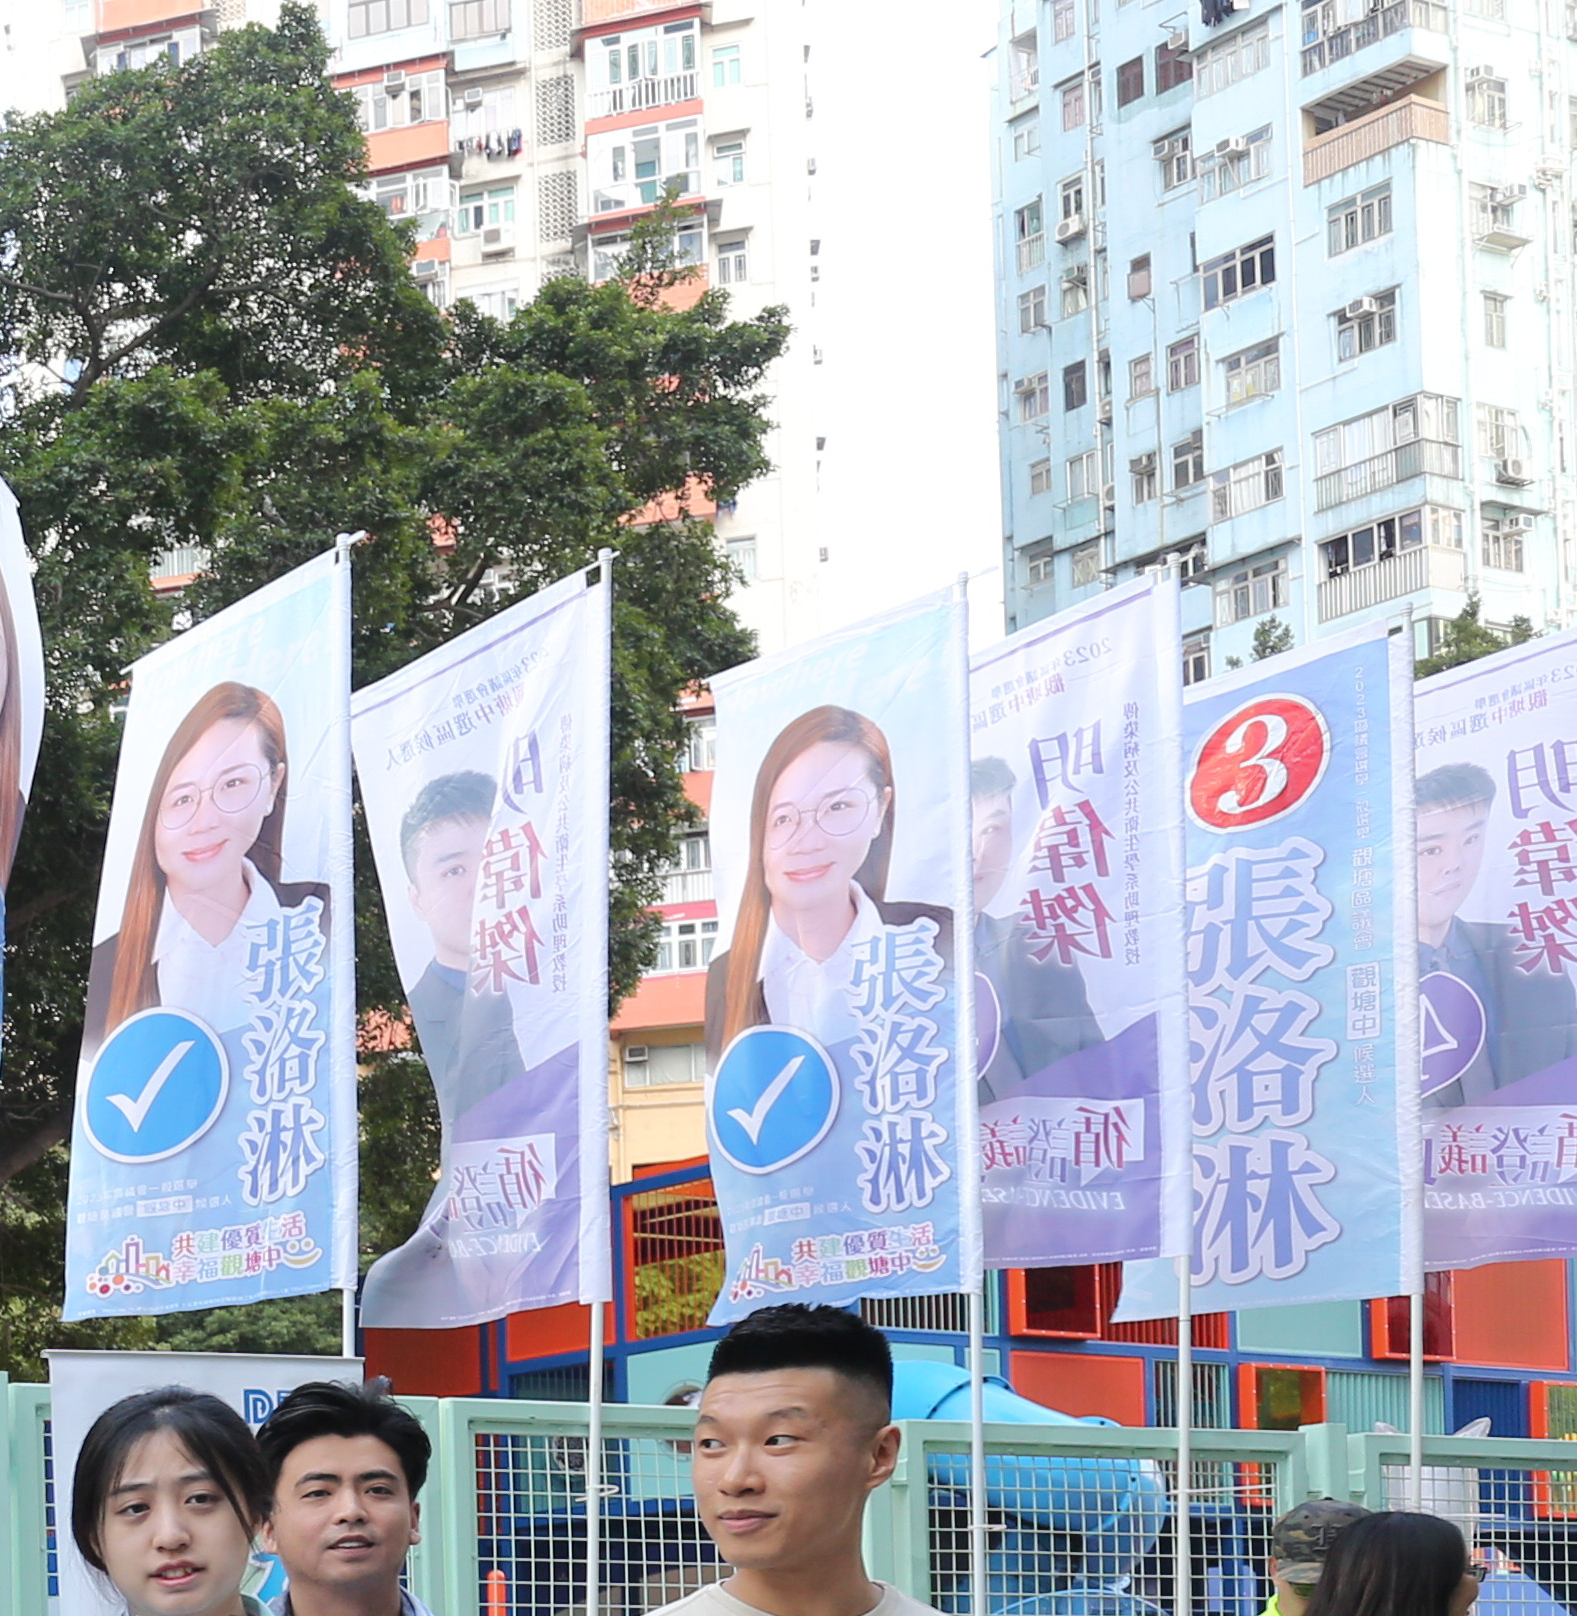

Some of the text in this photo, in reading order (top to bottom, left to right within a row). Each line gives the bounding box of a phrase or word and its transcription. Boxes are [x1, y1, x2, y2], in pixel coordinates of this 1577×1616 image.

[1219, 712, 1289, 816] 3
[1351, 965, 1377, 1036] 觀塘中
[244, 908, 322, 1197] 張洛淋
[854, 922, 947, 1207] 張洛淋
[1187, 846, 1329, 1273] 張洛淋
[1354, 1044, 1376, 1105] 候選人
[175, 1212, 305, 1257] 共建優質生活
[175, 1247, 282, 1284] 幸福觀塘中
[797, 1223, 933, 1261] 共建優質生活
[798, 1253, 912, 1286] 幸福觀塘中
